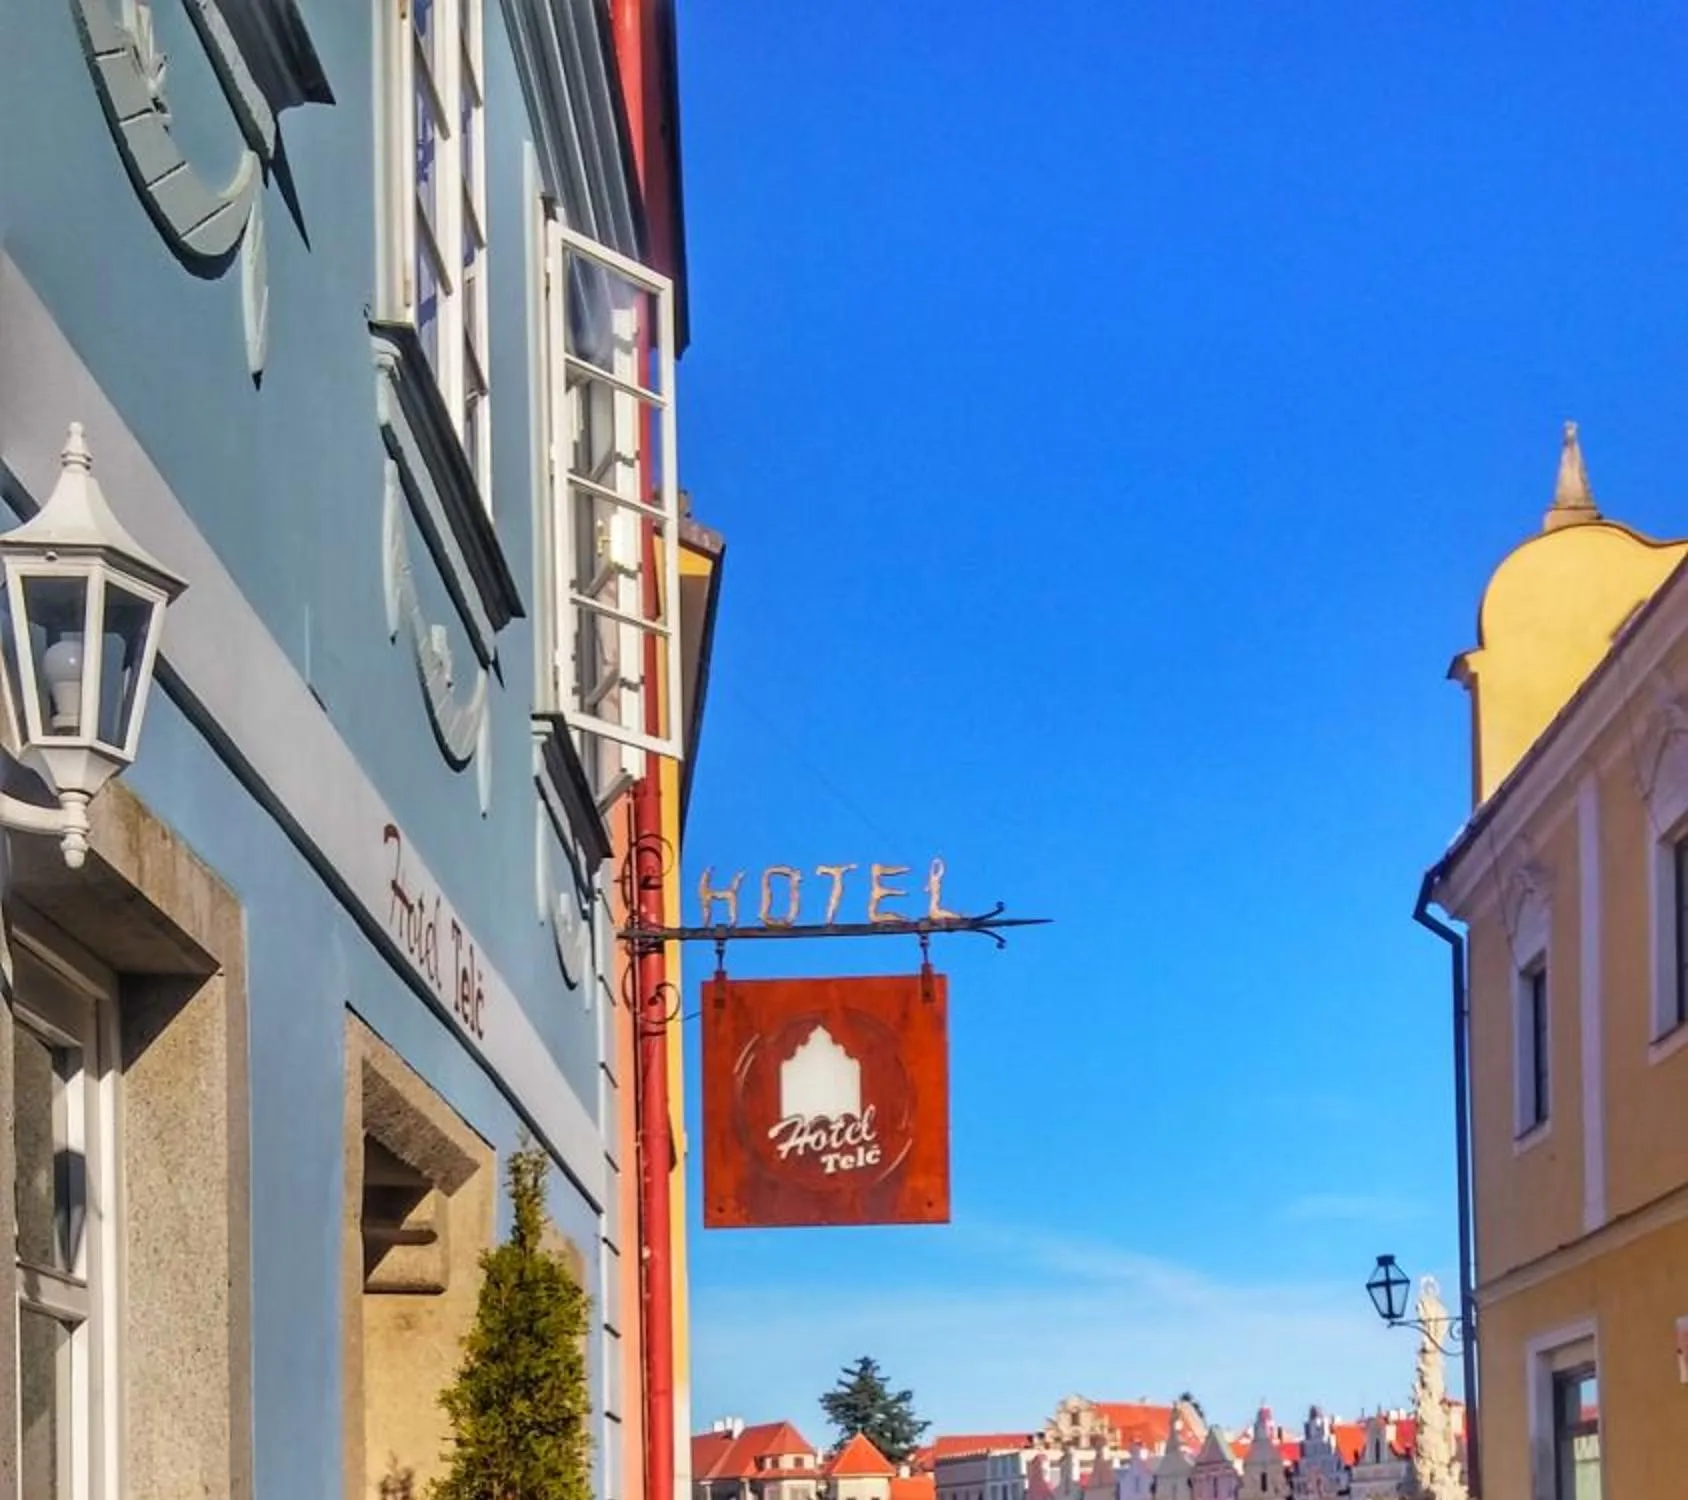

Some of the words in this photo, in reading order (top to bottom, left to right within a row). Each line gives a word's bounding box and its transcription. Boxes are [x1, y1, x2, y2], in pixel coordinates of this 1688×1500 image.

[383, 823, 442, 990] Hotel
[699, 856, 970, 927] HOTEL
[767, 1103, 878, 1160] Hotel
